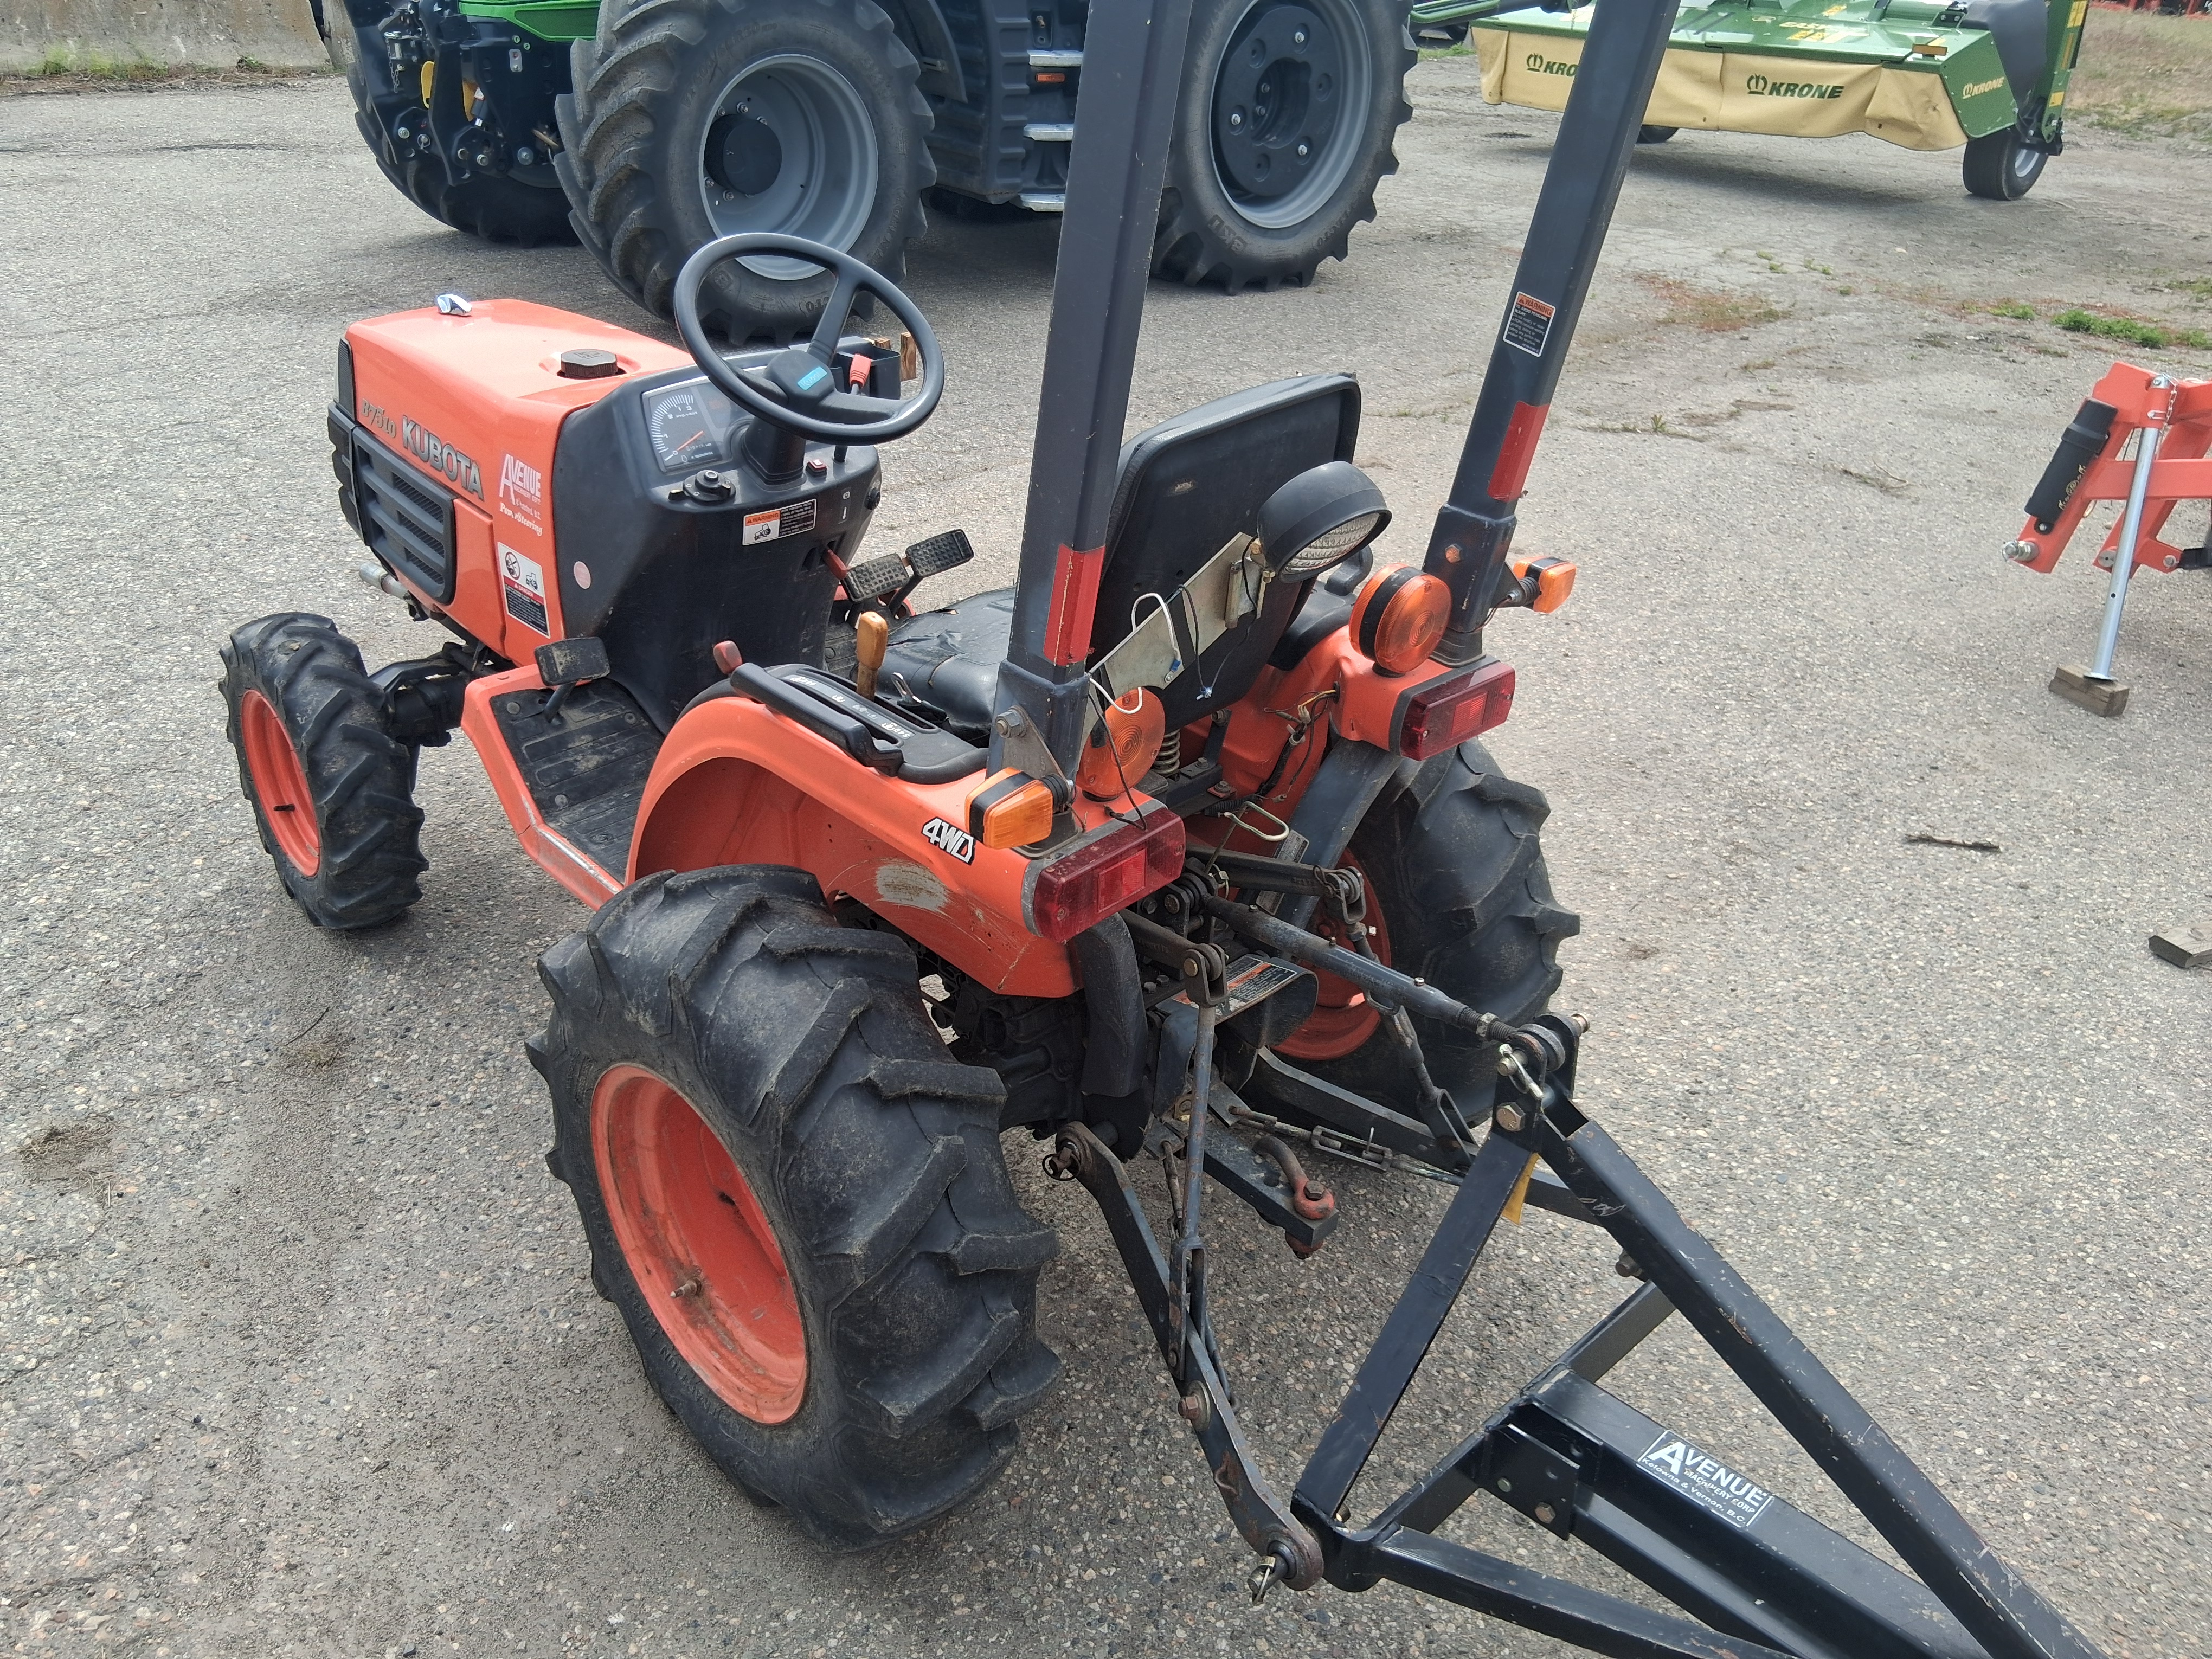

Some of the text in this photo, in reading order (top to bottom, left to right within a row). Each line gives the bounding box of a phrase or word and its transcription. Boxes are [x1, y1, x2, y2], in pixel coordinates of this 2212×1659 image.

[1545, 61, 1579, 77] KRO
[1768, 82, 1844, 99] KRONE
[1972, 76, 2004, 97] KRONE
[1524, 298, 1553, 316] WARNING
[361, 398, 396, 438] B7510
[402, 415, 484, 501] KUBOTA
[499, 453, 541, 505] AVENUE
[752, 512, 779, 522] WARNING
[922, 817, 974, 864] 4WD
[1647, 1441, 1767, 1507] AVENUE
[1641, 1457, 1680, 1483] Kelowna
[1690, 1487, 1724, 1512] Vernon,
[1727, 1509, 1746, 1524] B.C.
[1731, 1499, 1756, 1514] CORP
